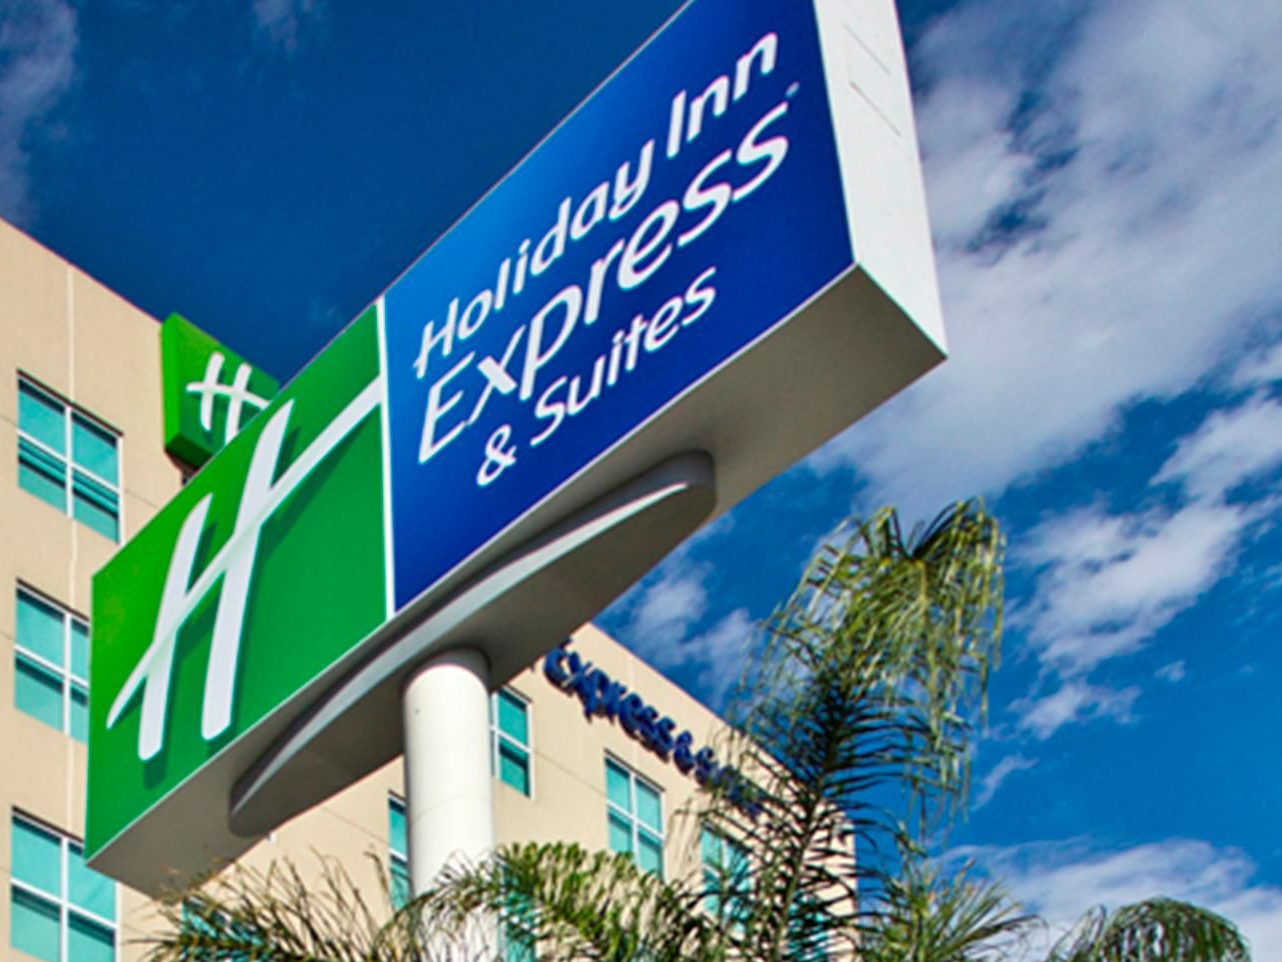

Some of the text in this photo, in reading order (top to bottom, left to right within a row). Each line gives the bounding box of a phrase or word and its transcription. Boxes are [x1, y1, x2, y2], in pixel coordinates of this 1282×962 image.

[412, 32, 778, 380] Holiday Inn
[418, 101, 789, 464] Express
[476, 265, 716, 487] & Suites
